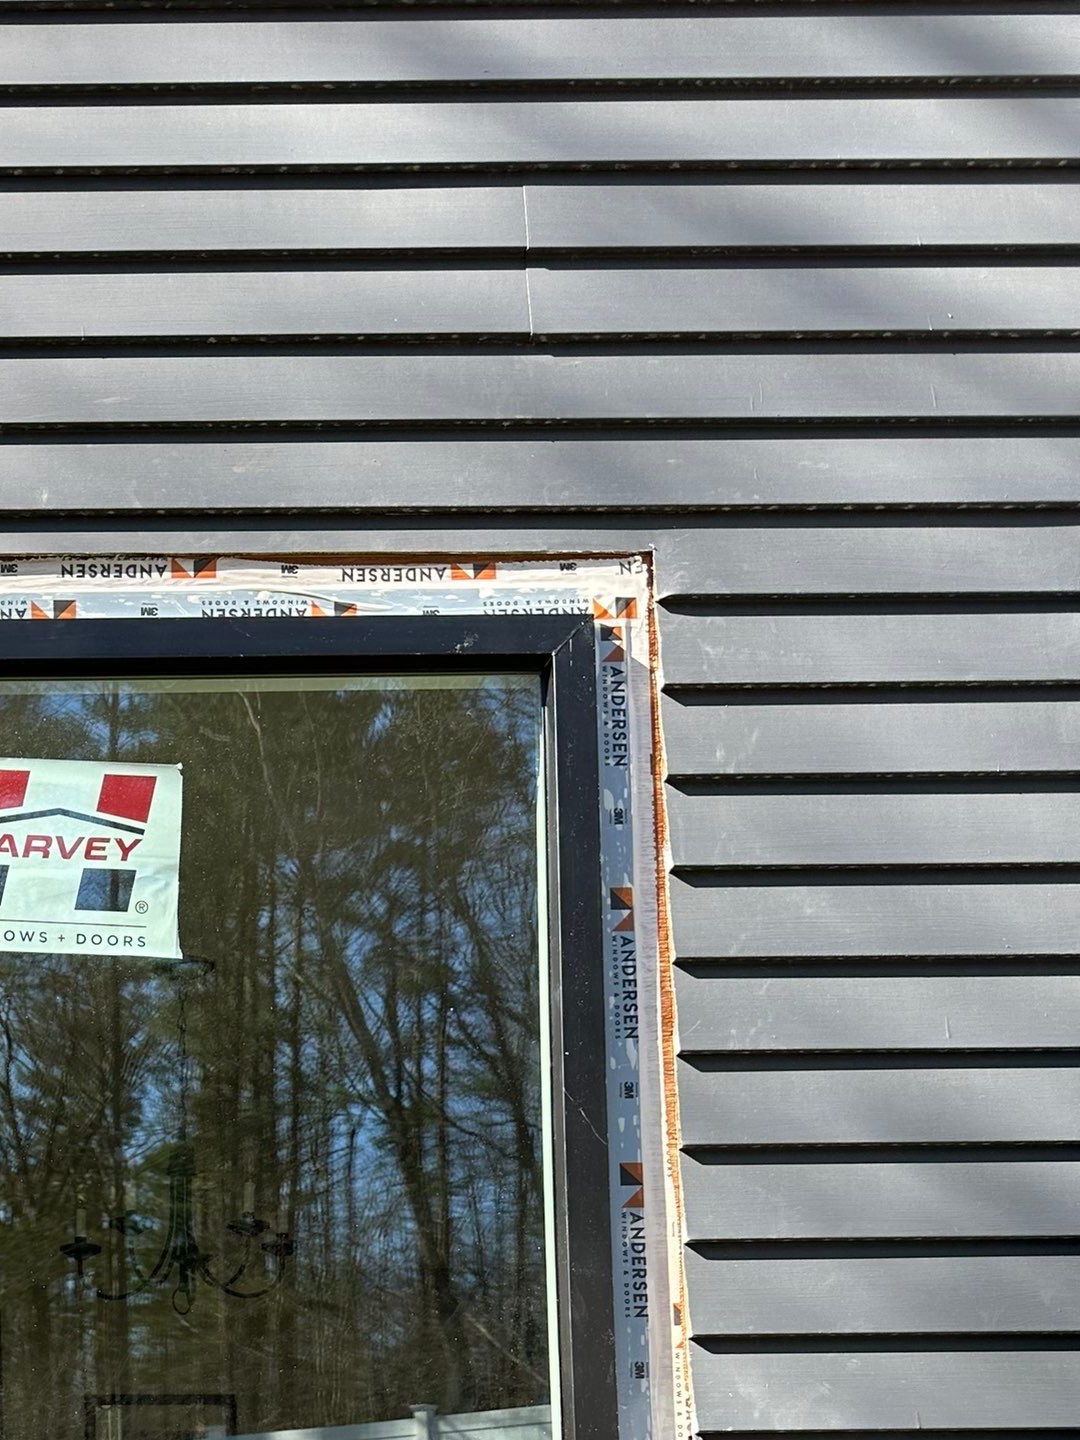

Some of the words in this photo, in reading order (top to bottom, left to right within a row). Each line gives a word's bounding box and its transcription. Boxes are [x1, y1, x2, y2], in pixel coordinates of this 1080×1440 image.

[1, 564, 18, 573] 3M
[61, 564, 167, 578] ANDERSEN
[281, 565, 298, 574] 3M
[341, 567, 447, 582] ANDERSEN
[560, 563, 577, 571] 3M
[141, 606, 158, 616] 3M
[202, 607, 307, 617] ANDERSEN
[610, 666, 628, 767] ANDERSEN
[614, 807, 624, 825] 3M
[76, 933, 147, 948] DOORS
[620, 936, 639, 1039] ANDERSEN
[624, 1081, 634, 1099] 3M
[630, 1212, 649, 1318] ANDERSEN
[634, 1361, 644, 1379] 3M
